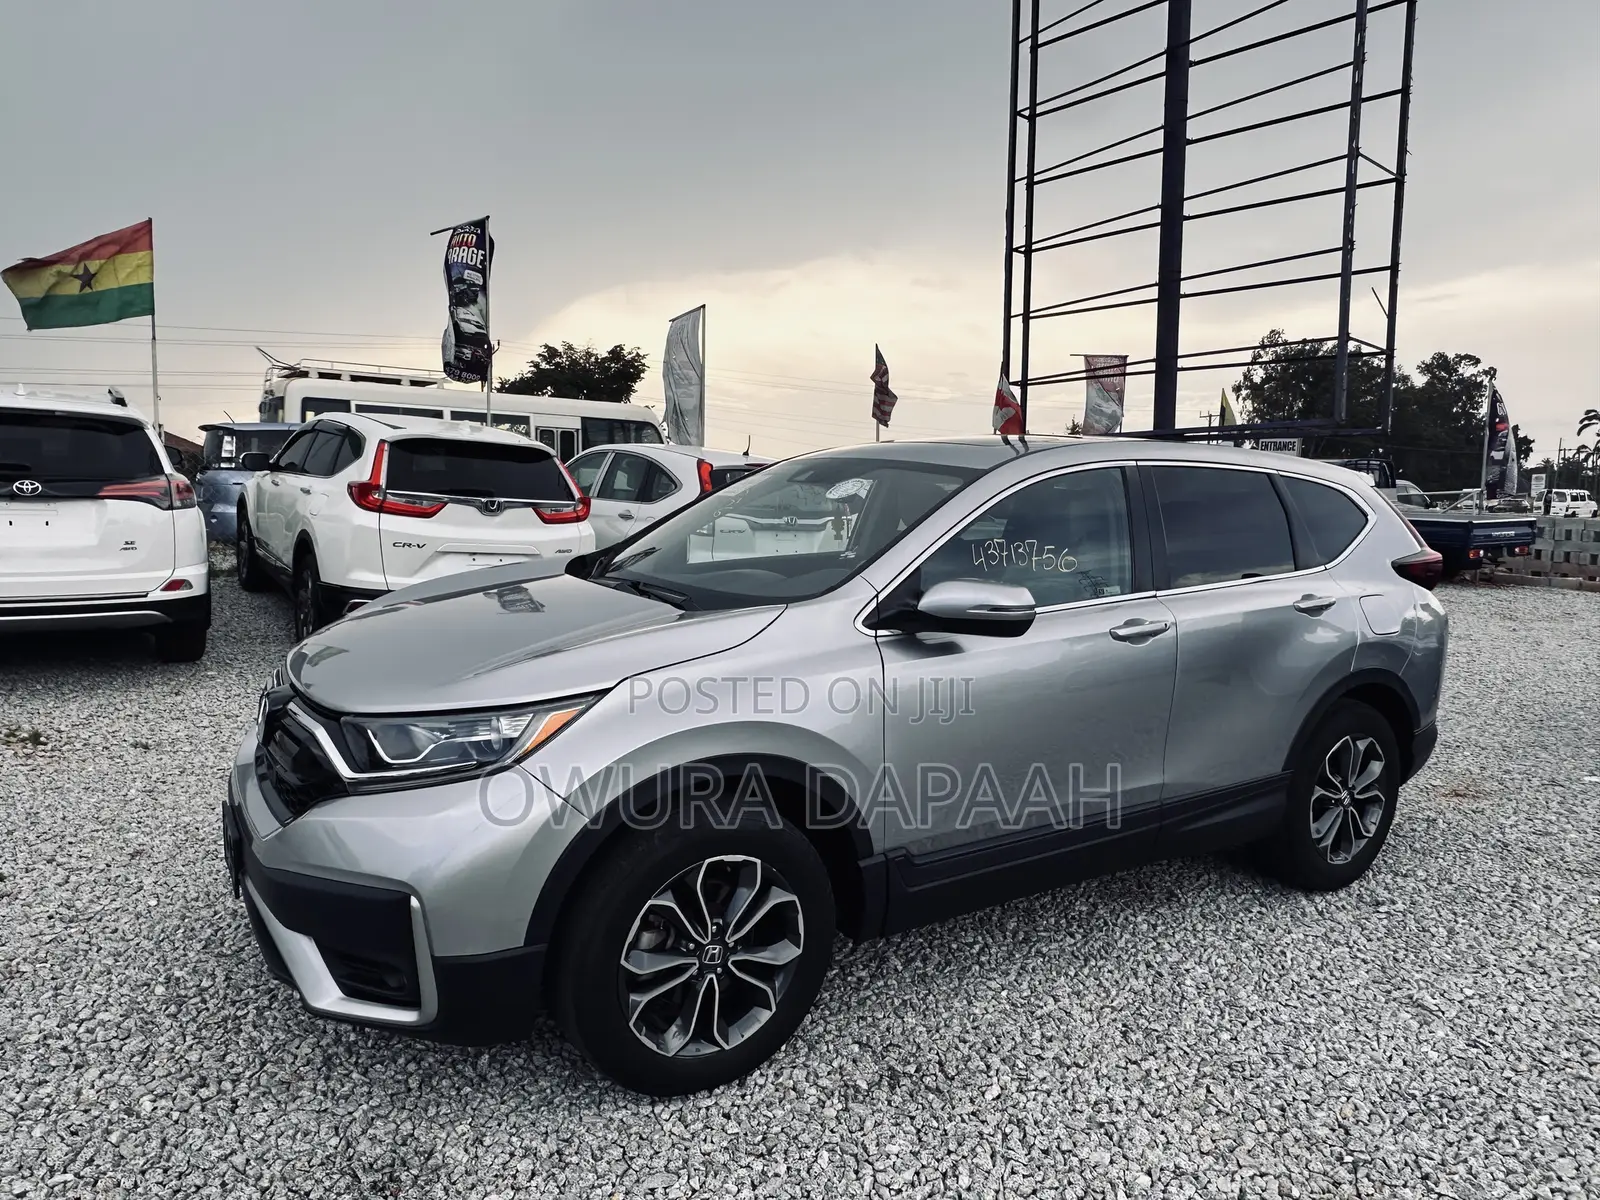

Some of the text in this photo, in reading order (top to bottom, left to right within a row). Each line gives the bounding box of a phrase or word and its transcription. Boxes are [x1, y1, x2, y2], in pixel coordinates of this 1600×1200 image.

[1260, 440, 1297, 452] ENTRANCE
[392, 541, 427, 549] CR-V
[971, 538, 1078, 573] 43713756
